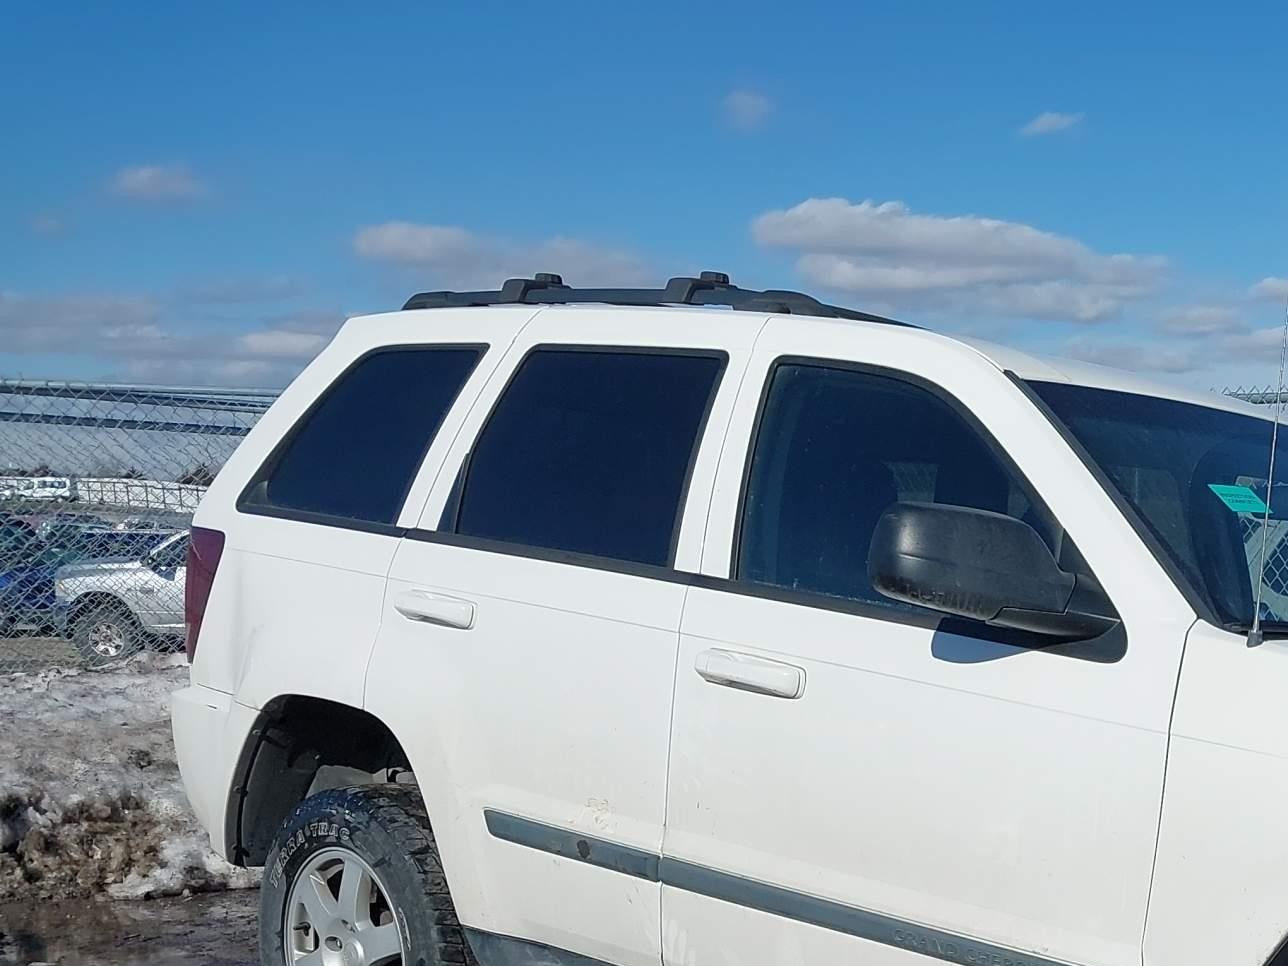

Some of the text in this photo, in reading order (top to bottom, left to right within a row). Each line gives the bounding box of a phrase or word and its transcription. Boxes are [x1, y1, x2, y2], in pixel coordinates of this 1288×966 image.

[270, 821, 351, 889] TERRA TRAC
[893, 928, 959, 956] GRAND
